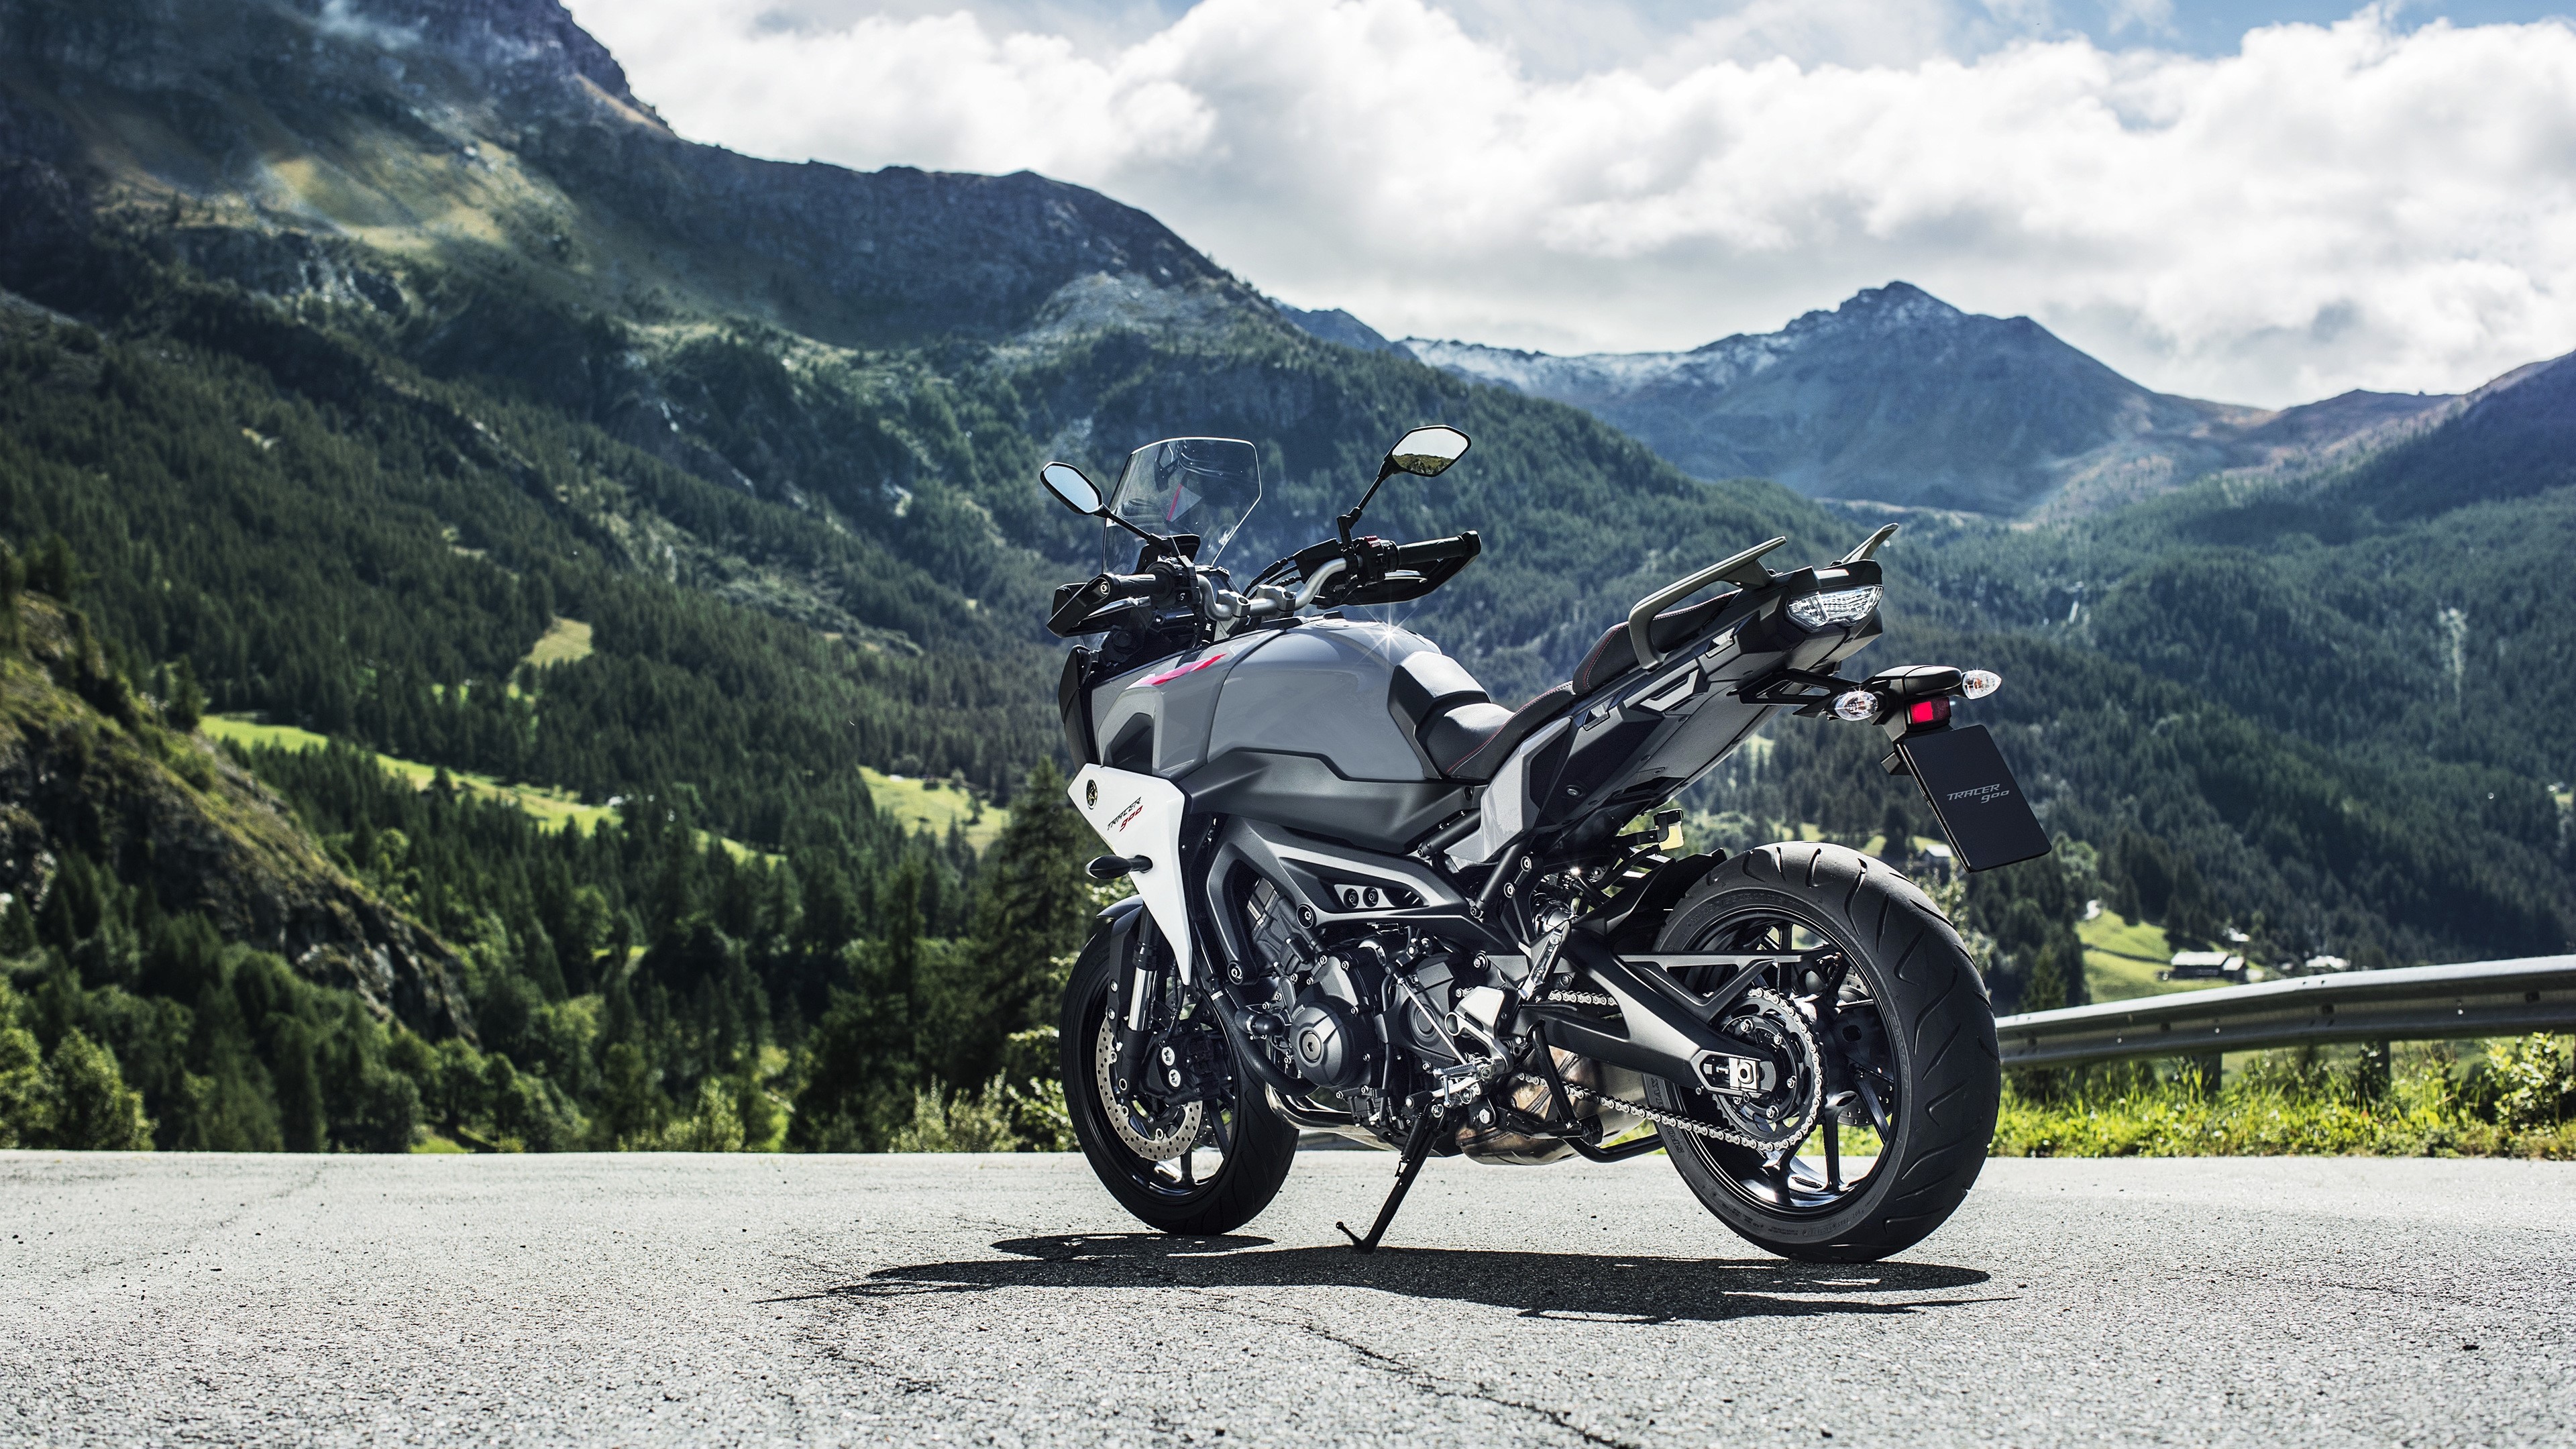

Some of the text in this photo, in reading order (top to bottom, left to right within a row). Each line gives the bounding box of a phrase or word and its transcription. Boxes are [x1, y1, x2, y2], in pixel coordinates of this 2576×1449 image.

[1947, 784, 2000, 800] TRACER
[1981, 790, 2009, 804] 900
[1107, 796, 1141, 831] TRACER
[1120, 805, 1143, 832] 900
